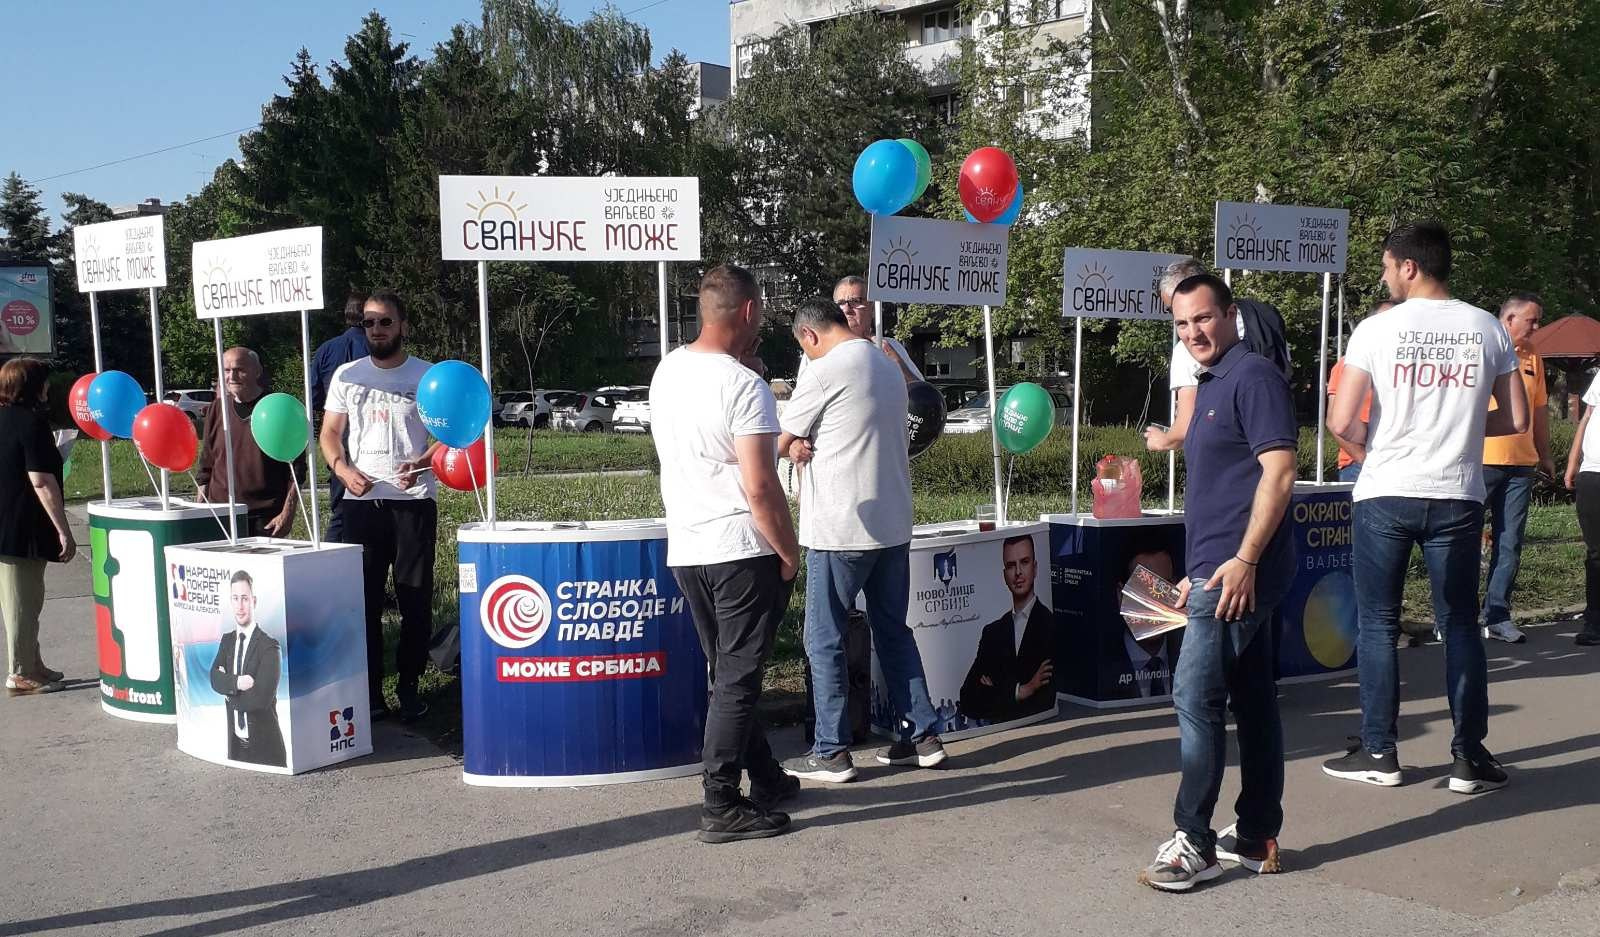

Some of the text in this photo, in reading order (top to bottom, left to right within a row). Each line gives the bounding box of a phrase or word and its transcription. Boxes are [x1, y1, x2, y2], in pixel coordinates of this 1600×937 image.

[604, 188, 678, 203] УЈЕДИЊЕНО
[604, 205, 656, 220] ВАЉЕВО
[463, 219, 678, 251] СВАНУЋЕ МОЖЕ
[960, 241, 1002, 255] УЈЕДИЊЕНО
[1226, 236, 1337, 265] СВАНУЋЕ МОЖЕ
[81, 255, 157, 284] СВАНУЋЕ МОЖЕ
[876, 263, 1000, 293] СВАНУЋЕ МОЖЕ
[201, 276, 313, 310] СВАНУЋЕ МОЖЕ
[1073, 287, 1145, 314] СВАНУЋЕ
[1398, 330, 1483, 345] УЈЕДИЊЕНО
[1396, 346, 1455, 360] ВАЉЕВО
[1393, 363, 1480, 388] МОЖЕ
[186, 565, 230, 581] НАРОДНИ
[187, 578, 220, 592] ПОКРЕТ
[556, 579, 658, 600] СТРАНКА
[917, 584, 975, 601] НОВО ЛИЦЕ
[188, 592, 220, 606] СРБИЈЕ
[925, 596, 970, 613] СРБИЈЕ
[557, 597, 685, 622] СЛОБОДЕ И
[557, 620, 645, 642] ПРАВДЕ
[502, 656, 661, 678] МОЖЕ СРБИЈА
[1119, 669, 1170, 685] др Милош
[330, 737, 355, 753] НПС
